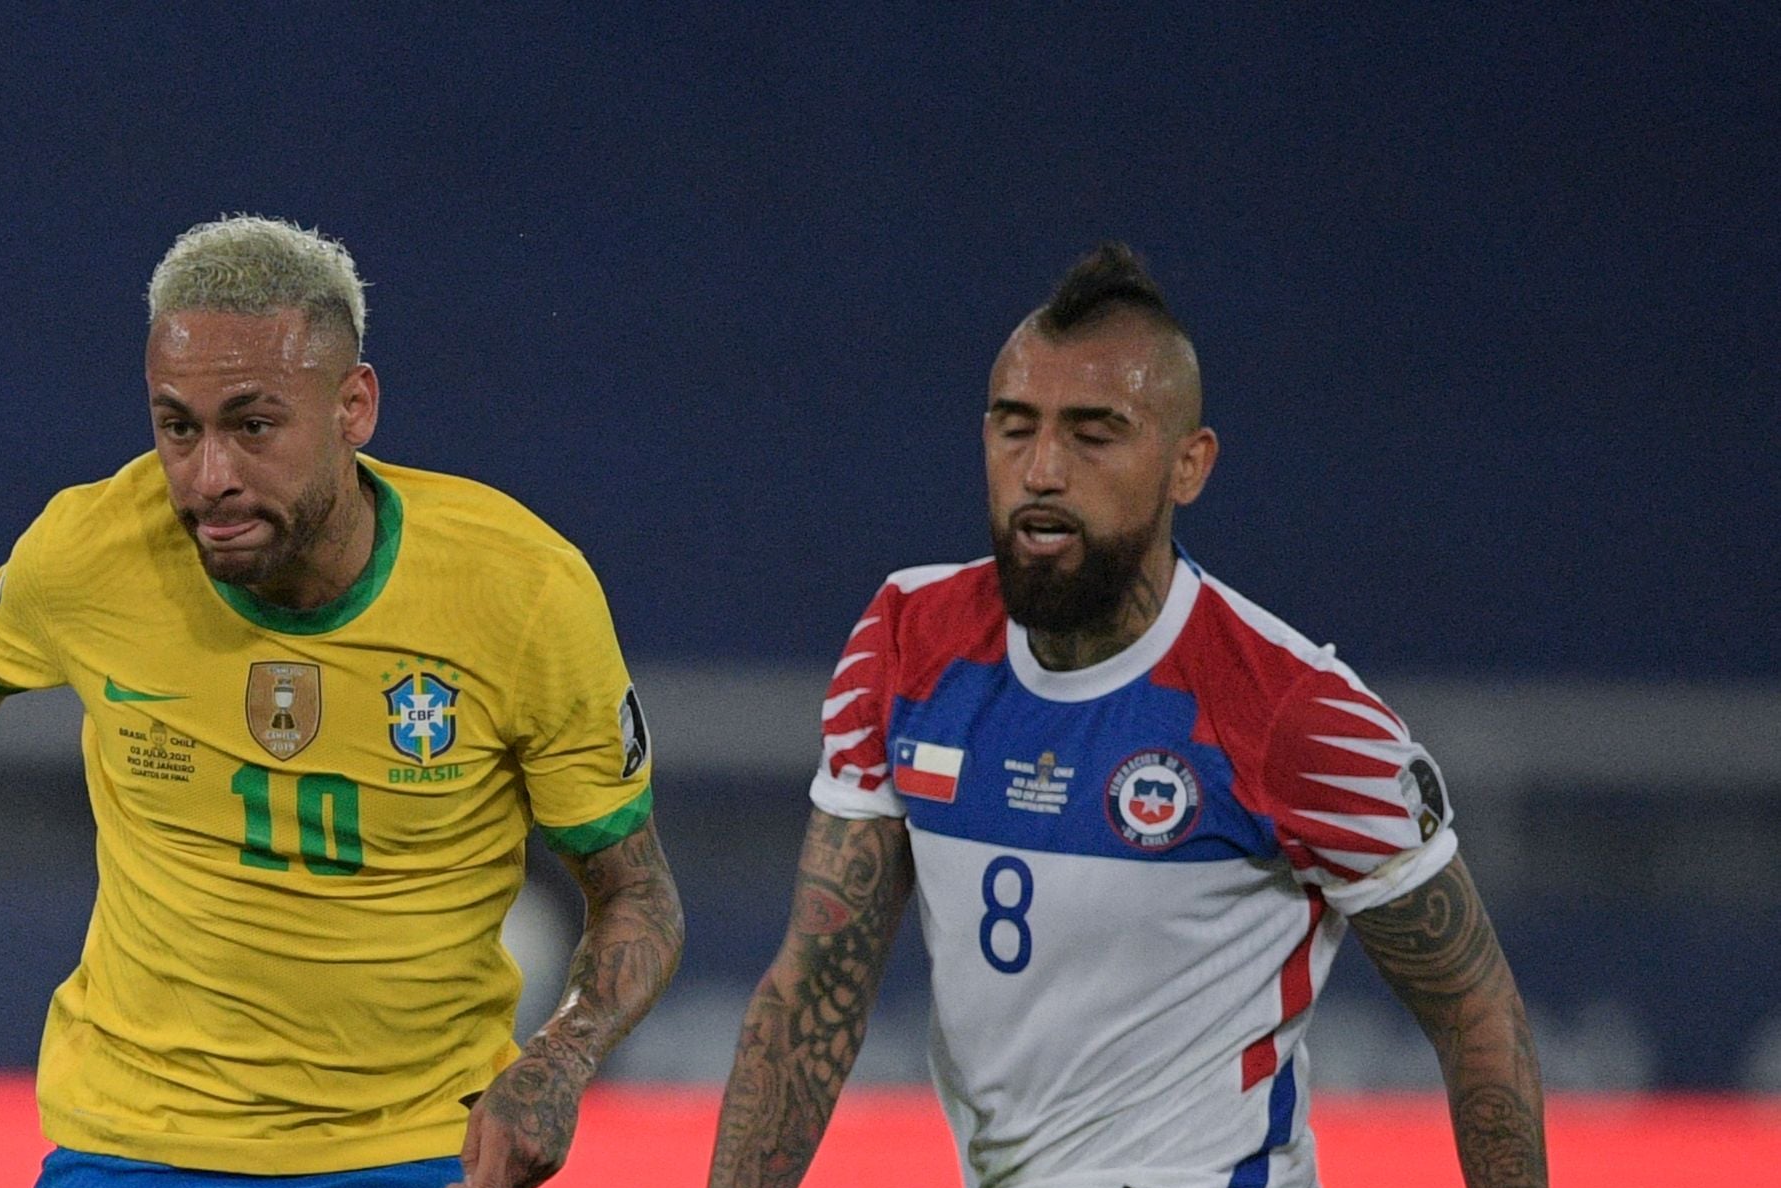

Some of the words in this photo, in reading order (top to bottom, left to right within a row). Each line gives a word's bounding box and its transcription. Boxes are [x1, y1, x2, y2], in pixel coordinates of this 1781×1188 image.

[408, 709, 435, 721] CBF
[119, 727, 148, 742] BRASIL
[170, 737, 196, 749] CHILE
[127, 755, 142, 766] RIO
[143, 759, 154, 769] DE
[156, 761, 196, 774] JANEIRO
[142, 748, 168, 759] JULIO
[170, 752, 192, 763] 2021
[388, 765, 465, 784] BRASIL
[230, 762, 365, 876] 10
[979, 854, 1034, 975] 8
